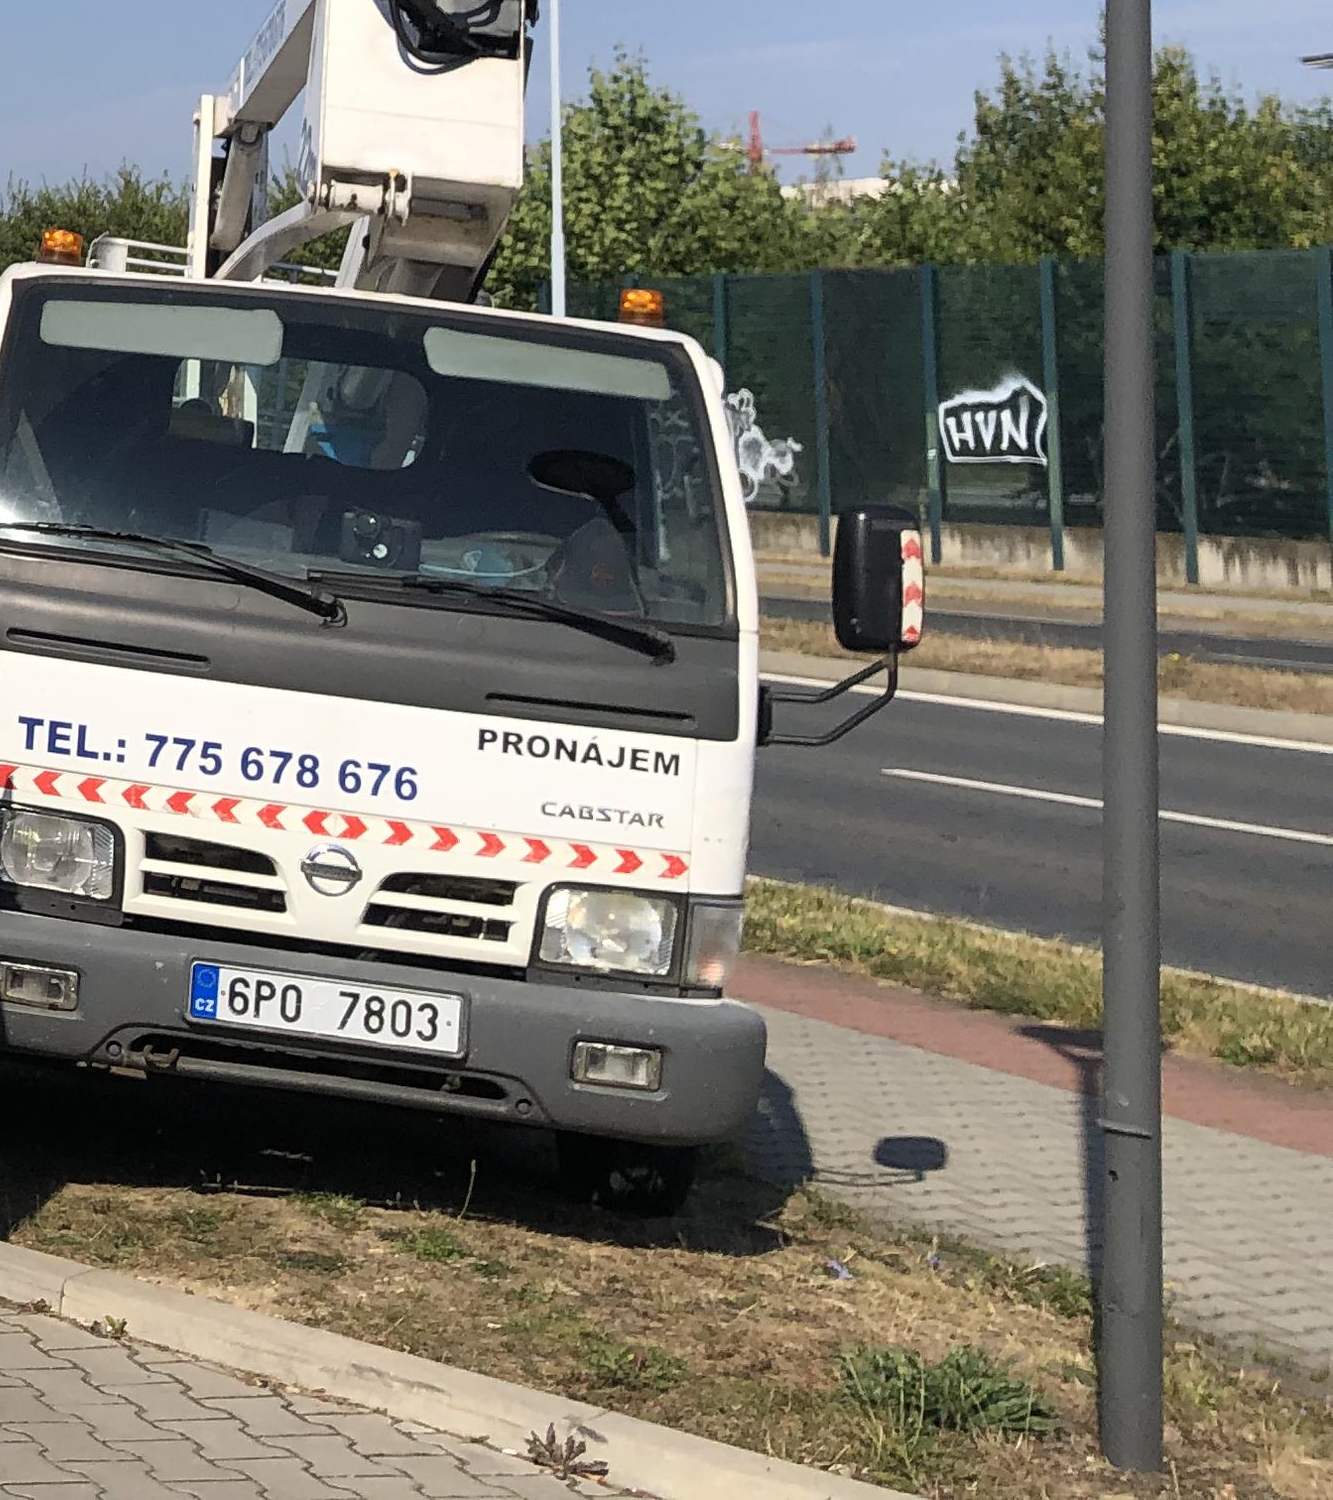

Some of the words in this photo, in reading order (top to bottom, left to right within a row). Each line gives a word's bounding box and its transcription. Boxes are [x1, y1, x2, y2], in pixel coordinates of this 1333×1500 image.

[18, 715, 127, 764] TEL.:
[144, 733, 223, 776] 775
[240, 746, 320, 788] 678
[337, 758, 419, 801] 676
[477, 728, 681, 777] PRONÁJEM
[540, 801, 665, 829] CABSTAR
[194, 997, 214, 1013] CZ
[228, 977, 303, 1023] 6P0
[337, 990, 440, 1042] 7803
